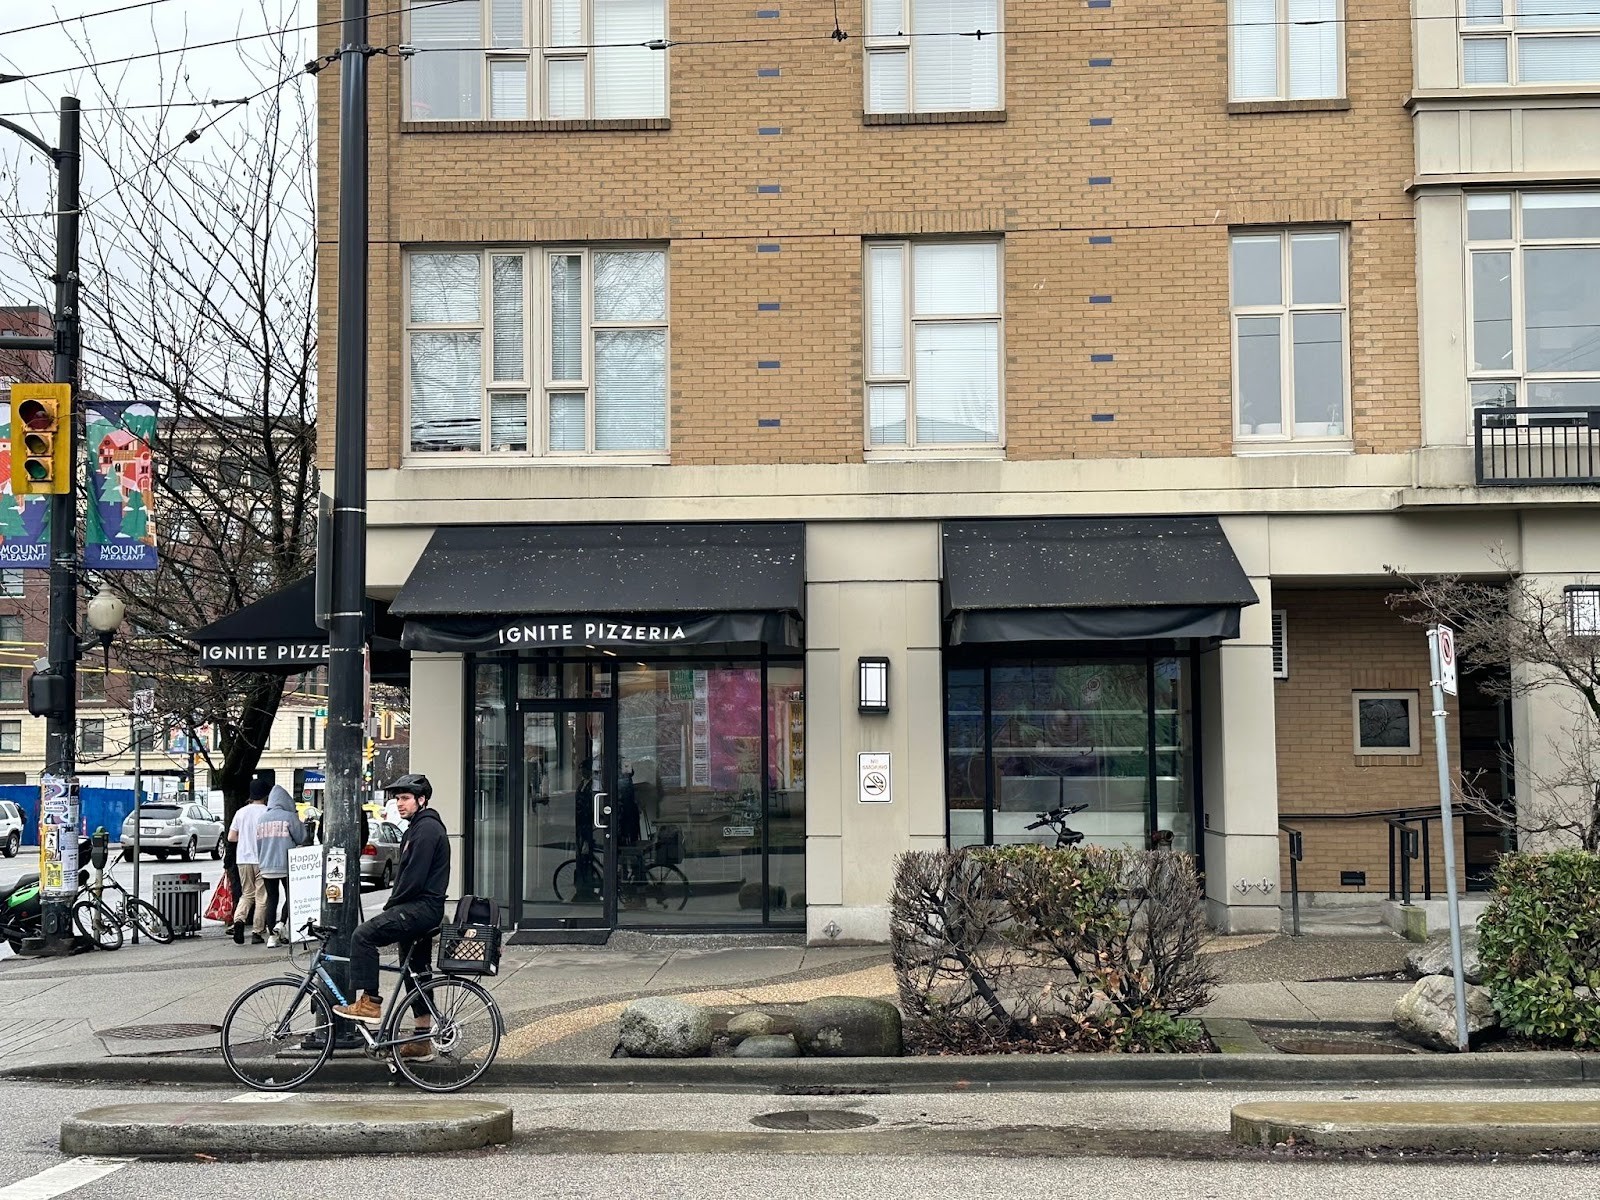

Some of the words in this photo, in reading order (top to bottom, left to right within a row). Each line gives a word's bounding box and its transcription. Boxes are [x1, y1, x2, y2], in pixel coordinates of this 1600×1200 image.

[0, 544, 47, 555] MOUNT
[101, 544, 145, 555] MOUNT
[0, 552, 47, 562] PLEASANT
[100, 552, 145, 561] PLEASANT
[498, 624, 573, 644] IGNITE
[585, 622, 686, 640] PIZZERIA
[202, 645, 267, 660] IGNITE
[277, 644, 331, 660] PIZZE
[290, 853, 319, 863] Happy
[290, 859, 321, 871] Everyd
